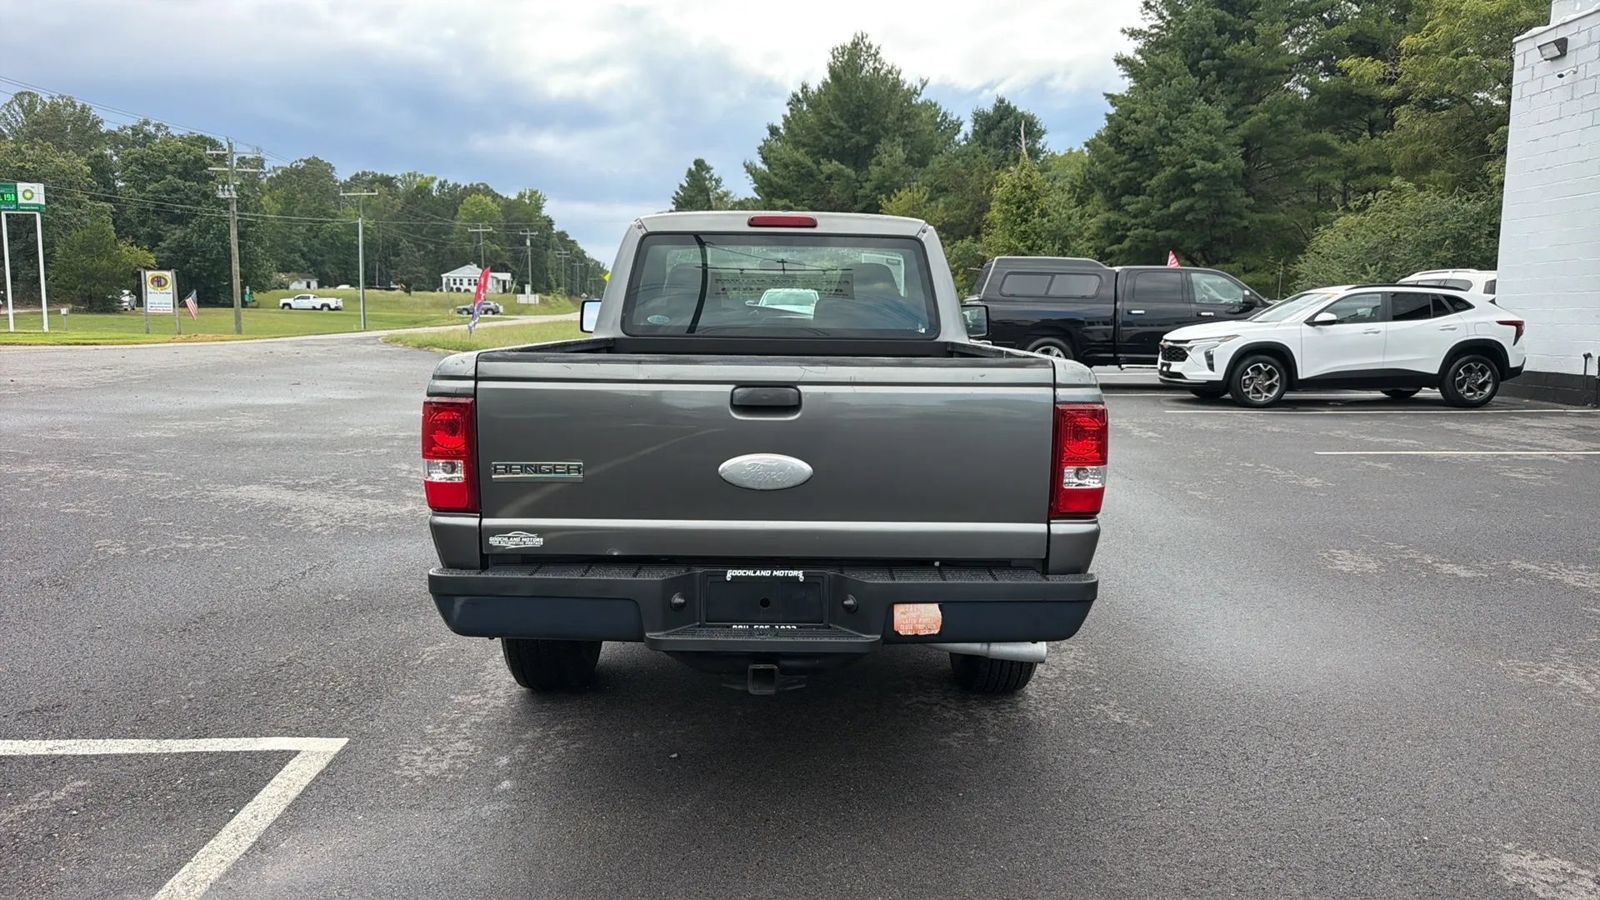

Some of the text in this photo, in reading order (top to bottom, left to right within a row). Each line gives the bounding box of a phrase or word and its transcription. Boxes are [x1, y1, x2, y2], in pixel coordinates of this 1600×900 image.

[493, 463, 582, 475] RANGER
[726, 569, 804, 578] GOOCHLAND MOTORS
